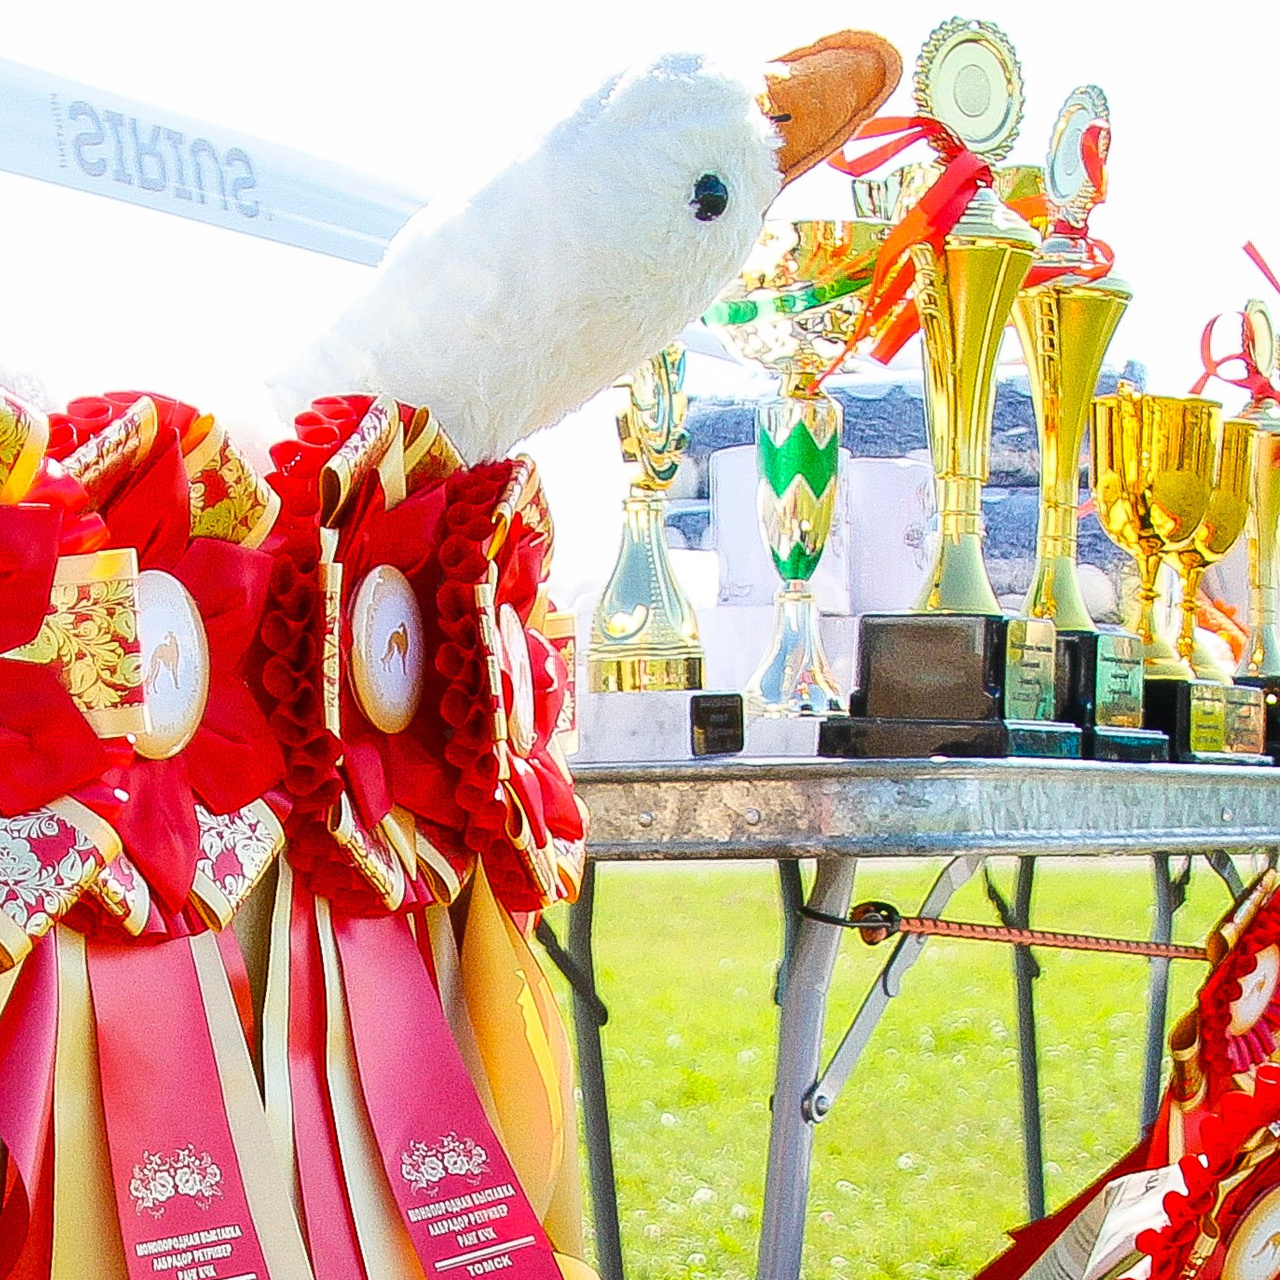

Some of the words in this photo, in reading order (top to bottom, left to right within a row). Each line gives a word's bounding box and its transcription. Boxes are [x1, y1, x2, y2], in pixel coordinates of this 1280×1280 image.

[407, 1195, 474, 1223] МОНОПОРОДНАЯ
[471, 1183, 516, 1206] ВЫСТАВКА
[428, 1214, 470, 1237] ЛАБРАДОР
[468, 1203, 509, 1226] РЕТРИВЕР
[135, 1232, 200, 1256] МОНОПОРОДНАЯ
[200, 1225, 243, 1244] ВЫСТАВКА
[153, 1252, 193, 1271] ЛАБРАДОР
[193, 1243, 233, 1263] РЕТРИВЕР
[466, 1254, 514, 1277] ТОМСК
